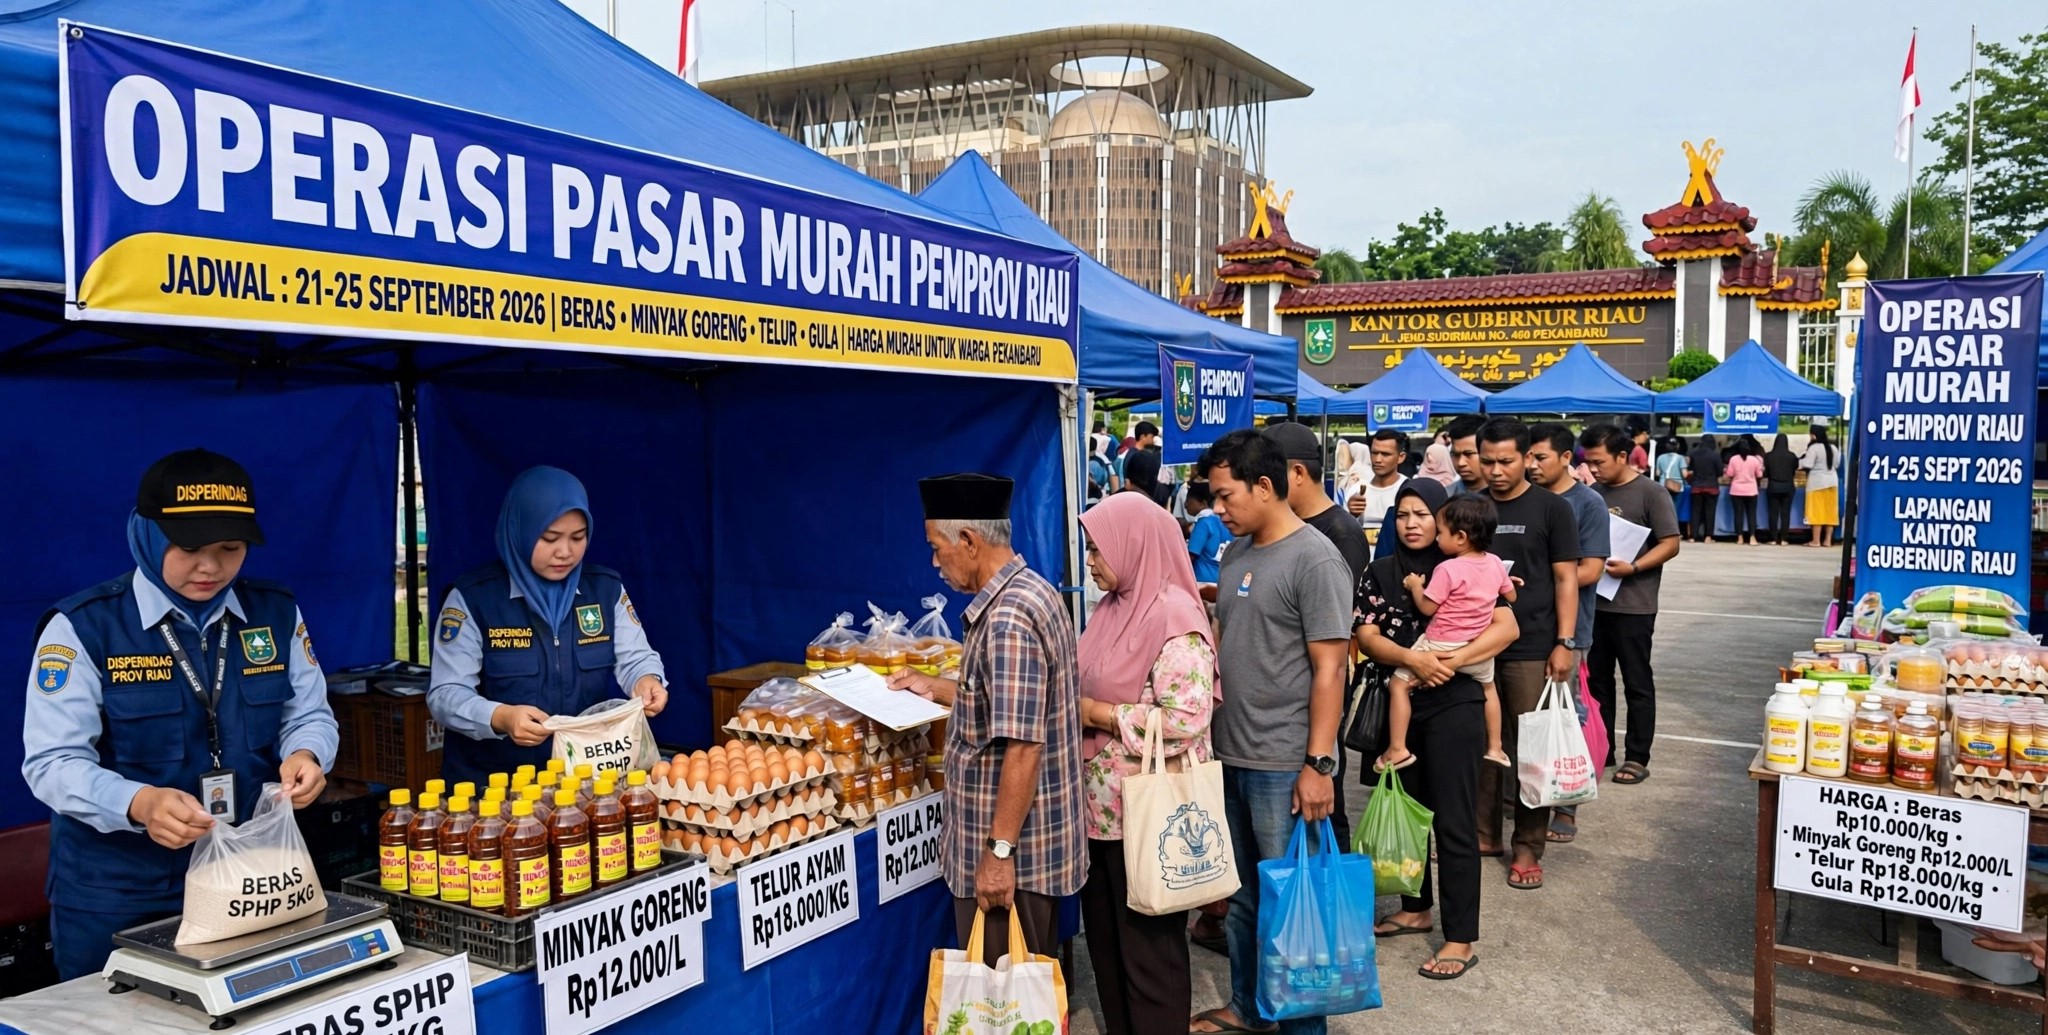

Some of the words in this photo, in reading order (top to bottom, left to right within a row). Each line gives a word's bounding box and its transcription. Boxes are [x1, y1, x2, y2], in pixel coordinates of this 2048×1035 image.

[104, 73, 528, 254] OPERASI
[552, 163, 747, 285] PASAR
[761, 207, 902, 302] MURAH
[910, 239, 1022, 320] PEMPROV
[1026, 264, 1071, 328] RIAU
[160, 253, 275, 302] JADWAL
[295, 267, 363, 309] 21-25
[369, 274, 495, 320] SEPTEMBER
[500, 288, 546, 325] 2026
[561, 295, 616, 331] BERAS
[631, 303, 688, 338] MINYAK
[692, 309, 747, 343] GORENG
[758, 317, 798, 347] TELUR
[808, 322, 839, 350] GULA
[848, 326, 884, 354] HARGA
[886, 330, 922, 357] MURAH
[924, 334, 956, 360] UNTUK
[958, 338, 990, 363] WARGA
[993, 342, 1042, 367] PEKANBARU
[1349, 313, 1442, 332] KANTOR
[1445, 308, 1580, 329] GUBERNUR
[1583, 306, 1647, 325] RIAU
[1879, 295, 2022, 333] OPERASI
[1488, 330, 1509, 340] NO.
[1533, 327, 1608, 340] PEKANBARU
[1892, 334, 2004, 368] PASAR
[1201, 368, 1245, 397] PEMPROV
[1884, 371, 2010, 403] MURAH
[1202, 399, 1226, 425] RIAU
[1881, 414, 1972, 441] PEMPROV
[1976, 414, 2024, 442] RIAU
[1869, 455, 1920, 481] 21-25
[1924, 456, 1971, 482] SEPT
[1975, 457, 2023, 484] 2026
[177, 483, 247, 502] DISPERINDAG
[1894, 496, 1991, 523] LAPANGAN
[1902, 522, 1976, 547] KANTOR
[1867, 544, 1965, 573] GUBERNUR
[1971, 550, 2016, 576] RIAU
[107, 655, 173, 670] DISPERINDAG
[112, 670, 143, 683] PROV
[146, 669, 172, 682] RIAU
[584, 735, 632, 759] BERAS
[1819, 786, 1888, 812] HARGA
[1906, 799, 1962, 823] Beras
[886, 808, 923, 846] GULA
[1836, 810, 1948, 848] Rp10.000/kg
[1792, 825, 1852, 850] Minyak
[1856, 835, 1916, 864] Goreng
[1921, 845, 2013, 877] Rp12.000/L
[242, 866, 303, 895] BERAS
[750, 861, 803, 907] TELUR
[806, 844, 846, 886] AYAM
[1808, 848, 1855, 871] Telur
[1861, 857, 1983, 898] Rp18.000/kg
[227, 898, 282, 917] SPHP
[286, 884, 314, 910] 5KG
[1811, 870, 1853, 893] Gula
[1860, 879, 1983, 920] Rp12.000/kg
[542, 904, 626, 972] MINYAK
[630, 876, 707, 937] GORENG
[752, 879, 849, 949] Rp18.000/KG
[567, 934, 686, 1019] Rp12.000/L
[373, 972, 455, 1028] SPHP
